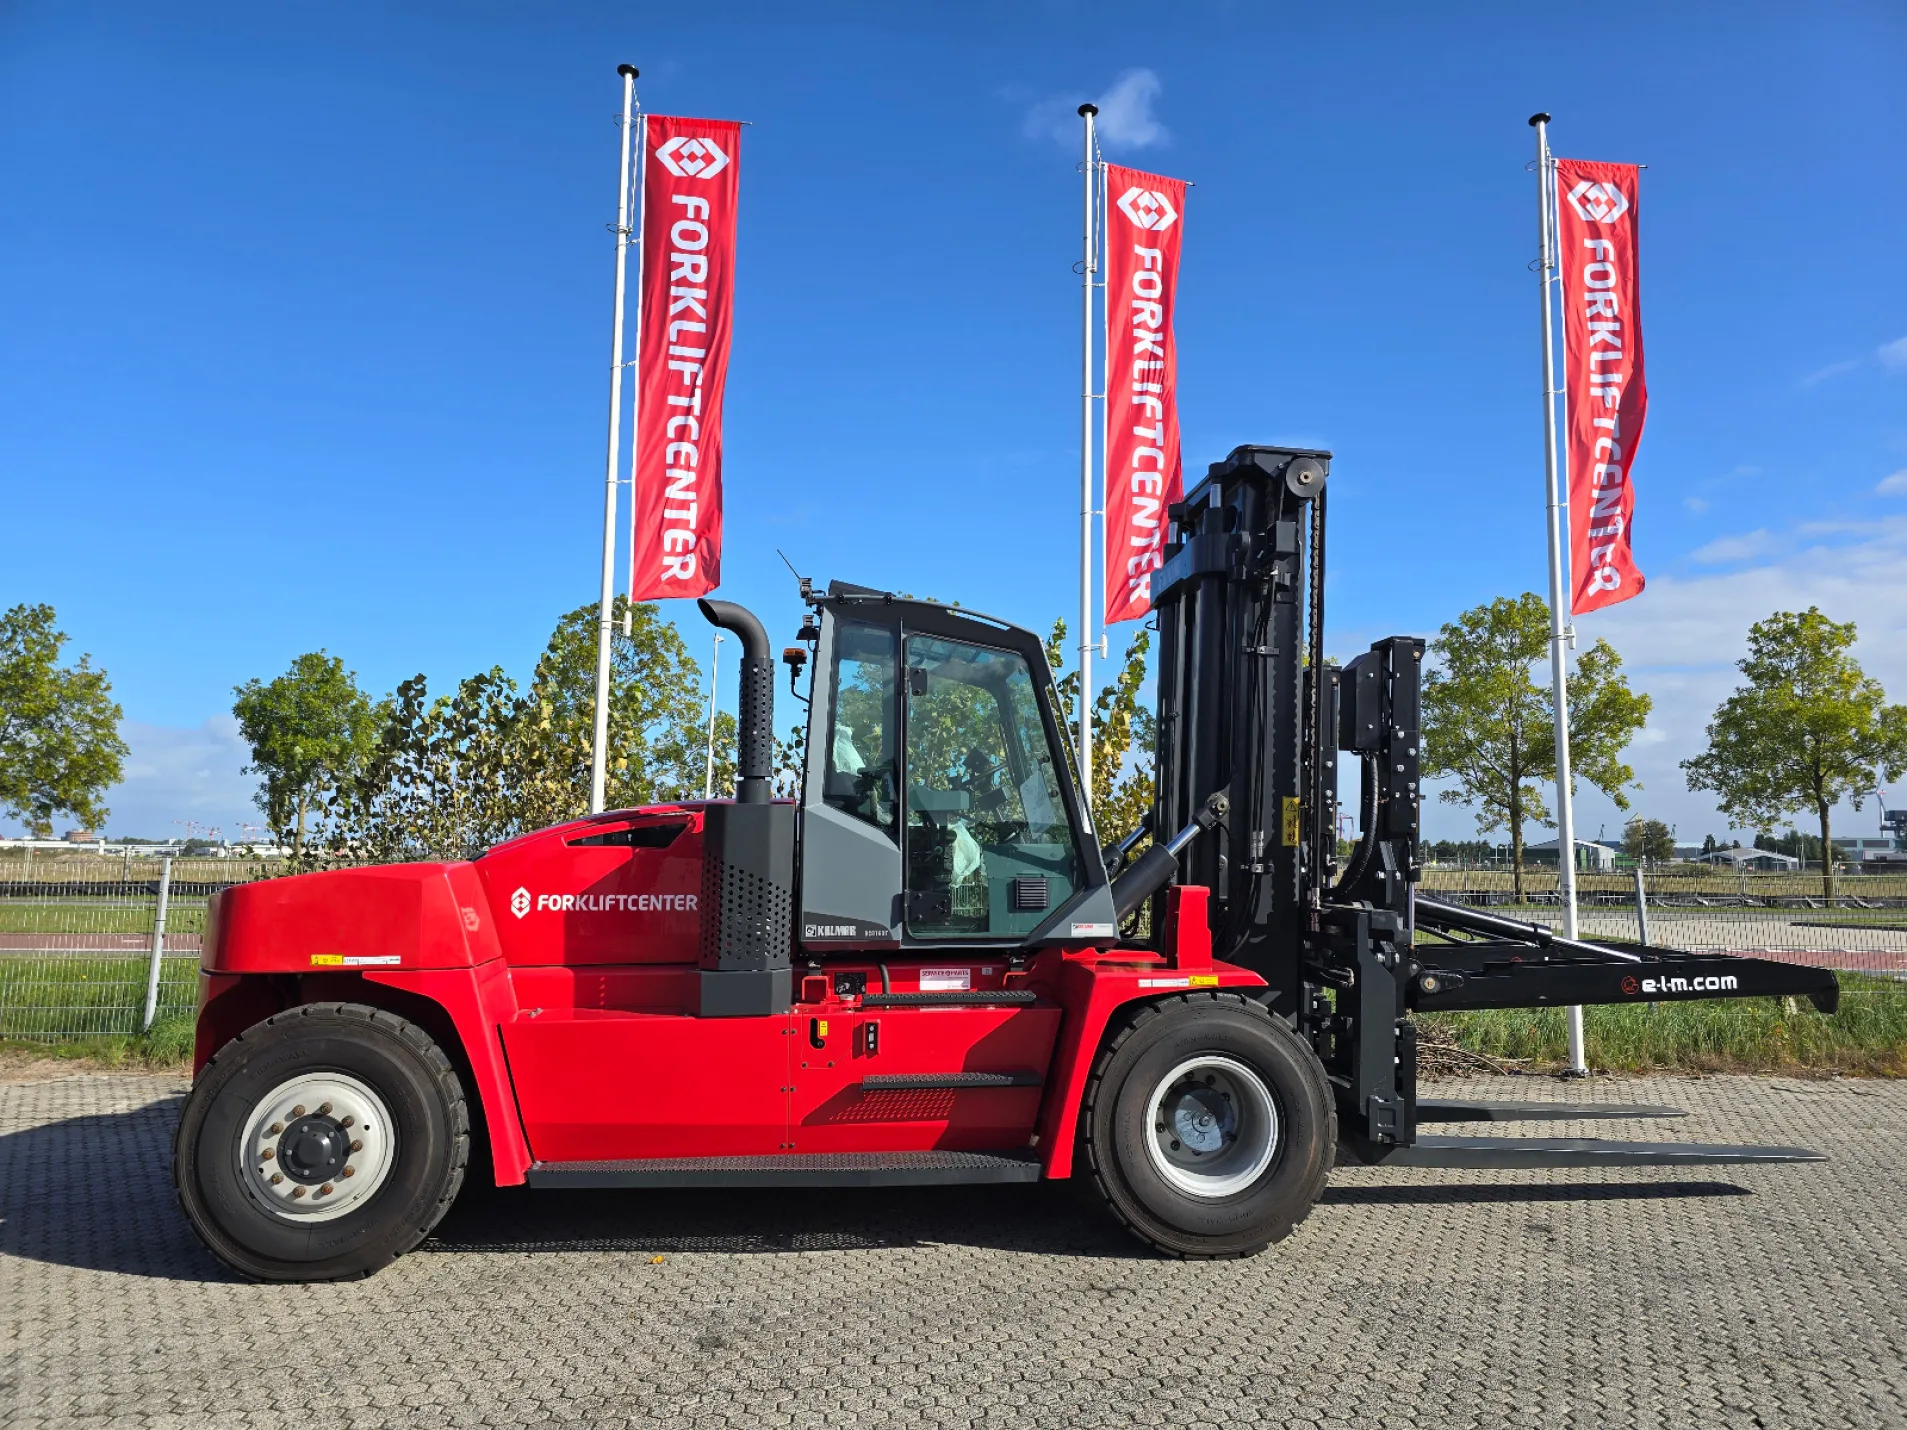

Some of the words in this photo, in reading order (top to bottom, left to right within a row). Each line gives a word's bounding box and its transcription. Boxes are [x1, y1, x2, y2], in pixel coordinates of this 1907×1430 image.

[660, 193, 710, 582] FORKLIFTCENTER
[1127, 243, 1165, 604] FORKLIFTCENTER
[1583, 238, 1625, 598] FORKLIFTCENTER
[537, 894, 698, 911] FORKLIFTCENTER
